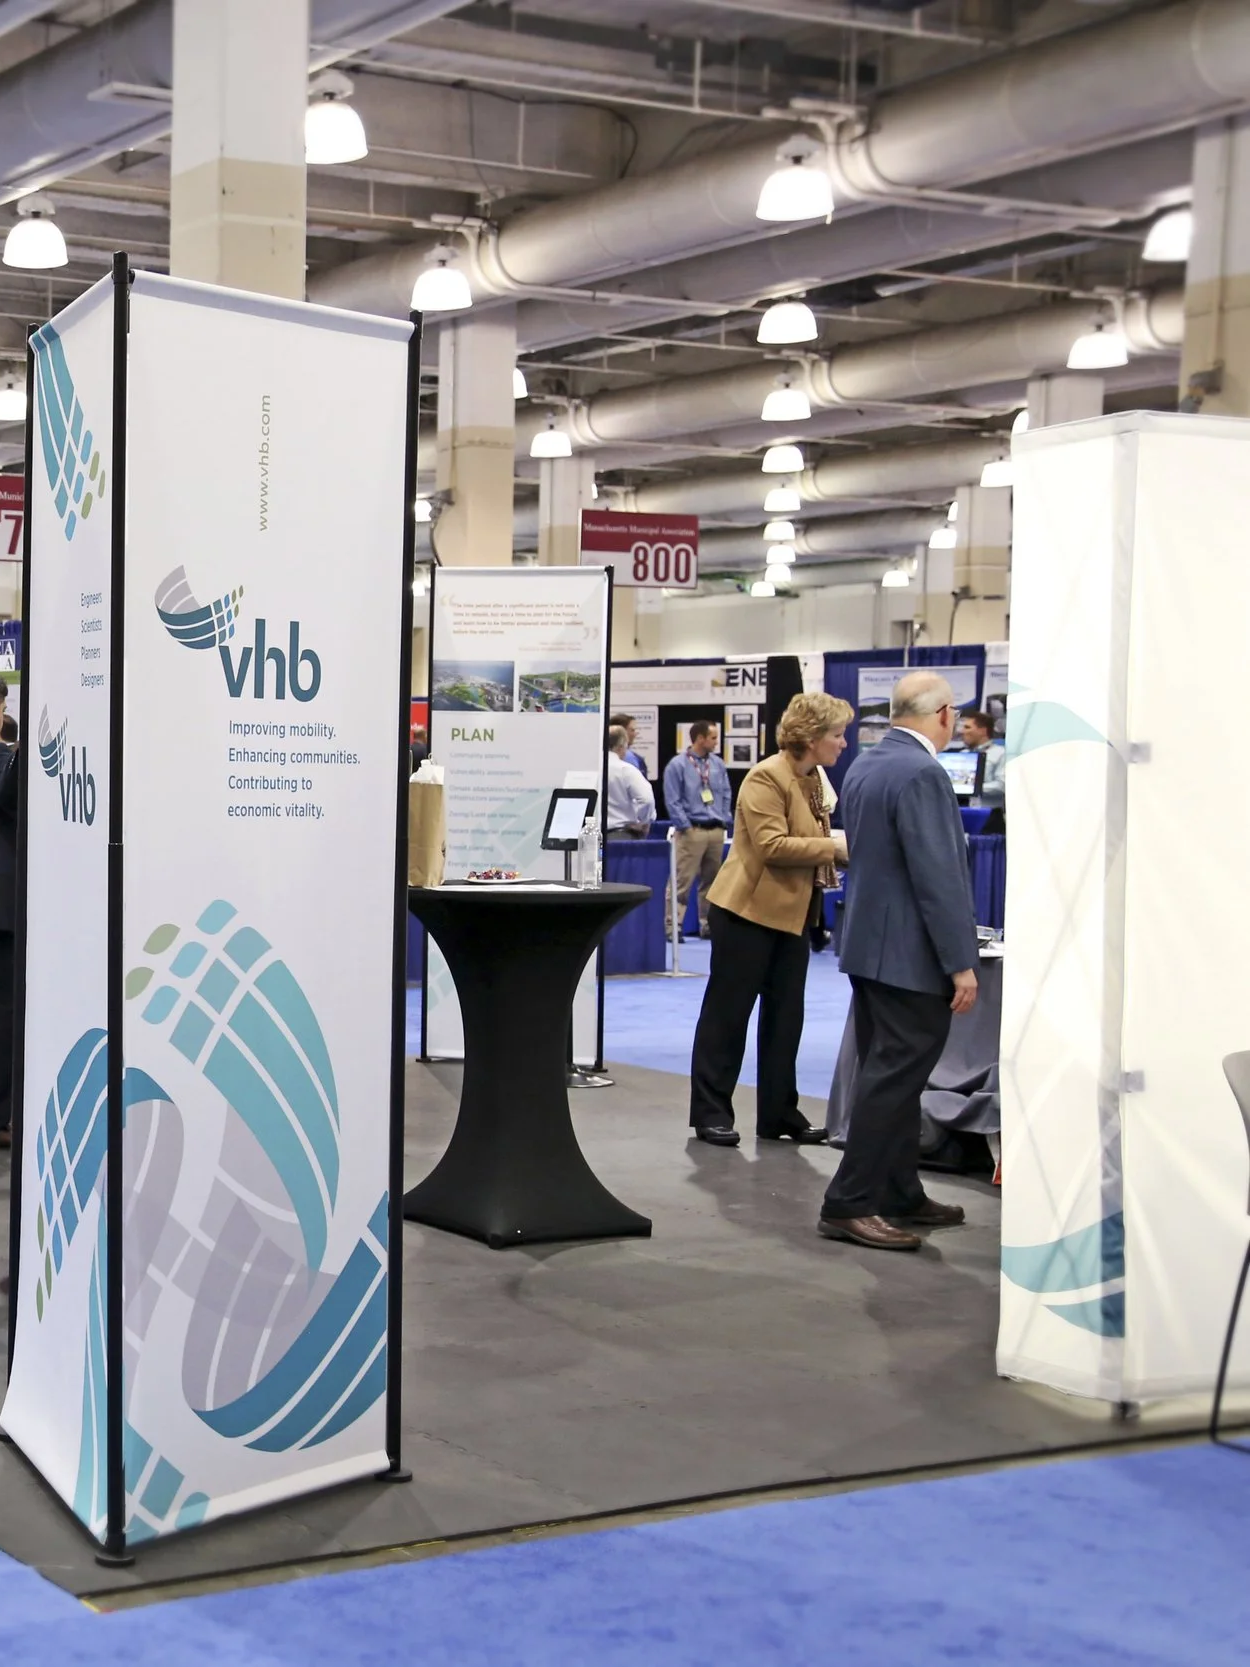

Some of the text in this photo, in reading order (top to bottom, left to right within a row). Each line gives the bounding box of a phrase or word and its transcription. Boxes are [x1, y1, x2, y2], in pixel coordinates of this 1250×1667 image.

[258, 394, 270, 532] www.vhb.com
[4, 514, 23, 555] 7
[633, 545, 691, 583] 800
[81, 592, 103, 608] Engineers
[81, 618, 103, 633] Scientists
[81, 645, 101, 660] Planners
[218, 618, 322, 703] vhb
[81, 673, 104, 688] Designers
[229, 720, 336, 740] Improving mobility.
[451, 727, 495, 742] PLAN
[228, 747, 361, 766] Enhancing communities.
[59, 746, 96, 826] vhb
[228, 775, 313, 793] Contributing to
[227, 803, 325, 820] economic vitality.
